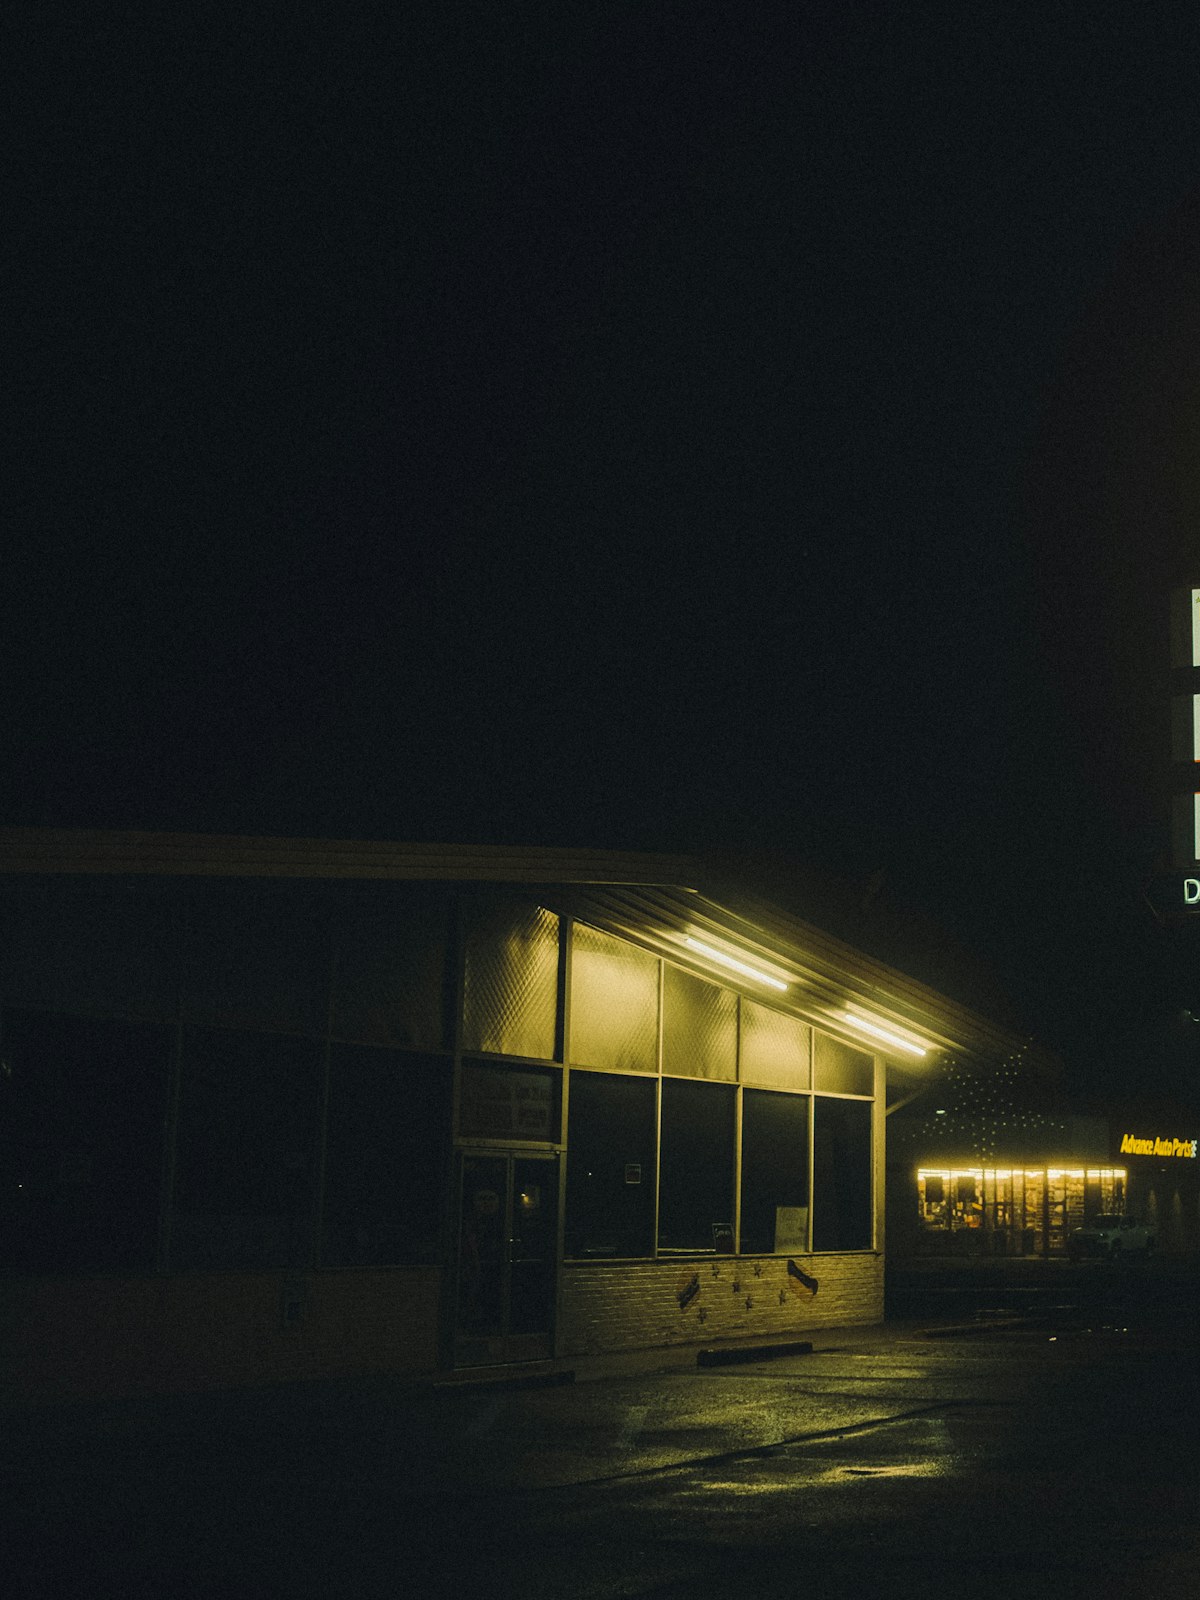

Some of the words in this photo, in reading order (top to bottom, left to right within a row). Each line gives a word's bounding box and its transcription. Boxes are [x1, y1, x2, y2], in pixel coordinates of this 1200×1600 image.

[1120, 1134, 1154, 1155] Advance
[1153, 1137, 1173, 1156] Auto
[1172, 1138, 1192, 1157] Parts
